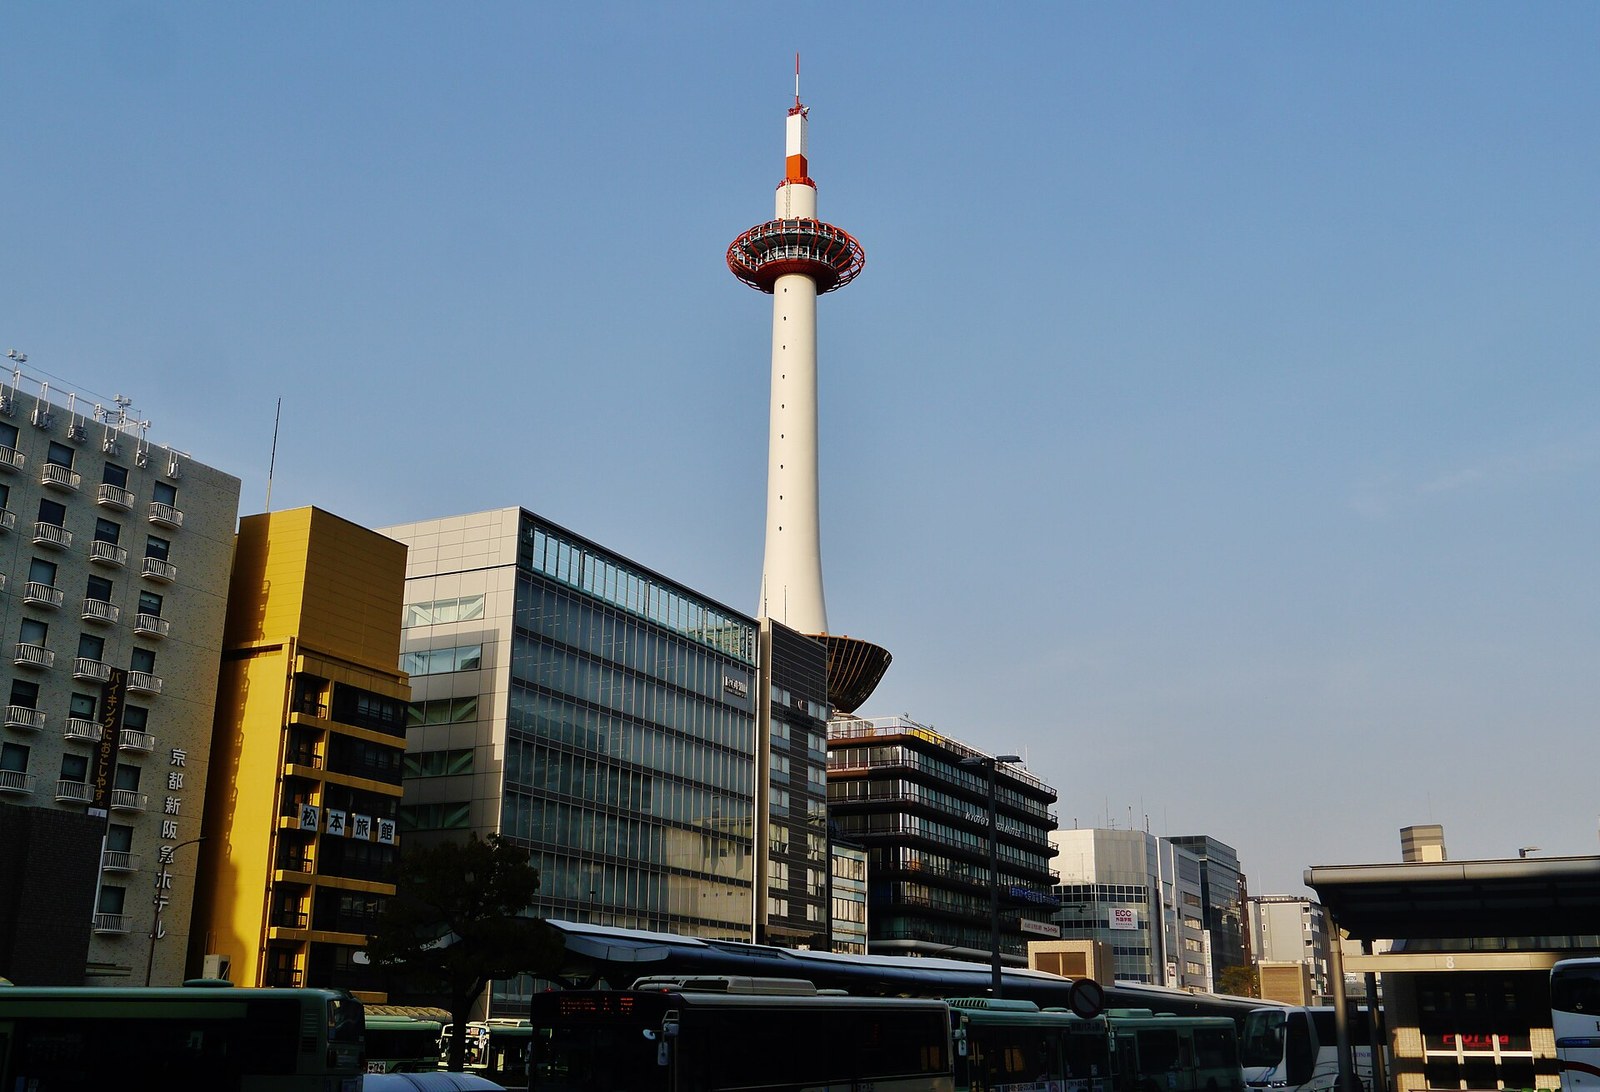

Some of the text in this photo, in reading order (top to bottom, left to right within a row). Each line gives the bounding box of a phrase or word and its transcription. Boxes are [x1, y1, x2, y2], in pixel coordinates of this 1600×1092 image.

[303, 807, 394, 841] 松本旅館
[965, 811, 986, 826] KYOTO
[1004, 825, 1022, 838] HOTEL
[150, 748, 188, 940] 京都新阪急ホテル
[1115, 909, 1132, 917] ECC
[1446, 956, 1455, 969] 8
